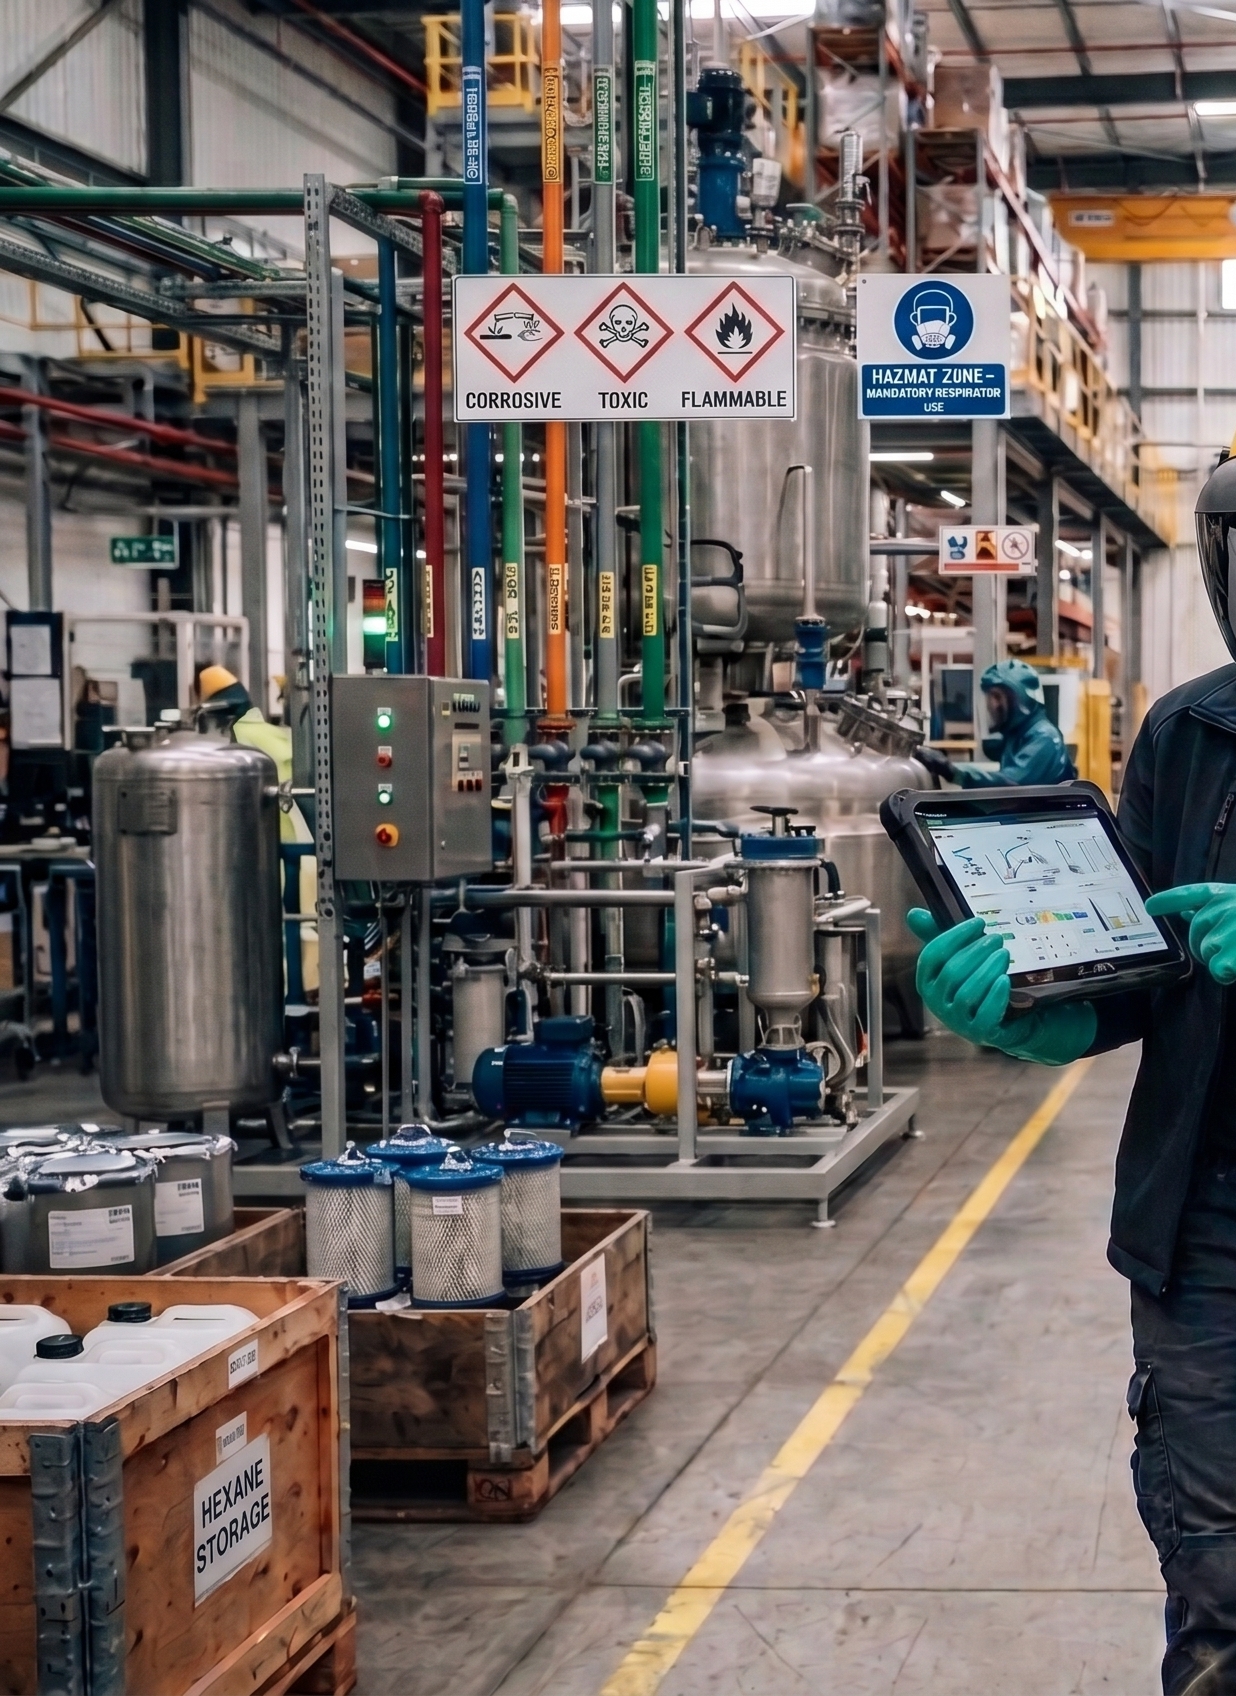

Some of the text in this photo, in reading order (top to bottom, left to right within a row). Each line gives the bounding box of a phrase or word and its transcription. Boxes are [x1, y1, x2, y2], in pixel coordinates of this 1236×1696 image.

[872, 368, 938, 384] HAZMAT
[465, 390, 787, 409] CORROSIVE TOXIC FLAMMABLE
[866, 387, 1001, 399] MANDATORY RESPIRATOR
[923, 402, 945, 412] USE
[201, 1458, 264, 1529] HEXANE
[196, 1492, 270, 1574] STORAGE
